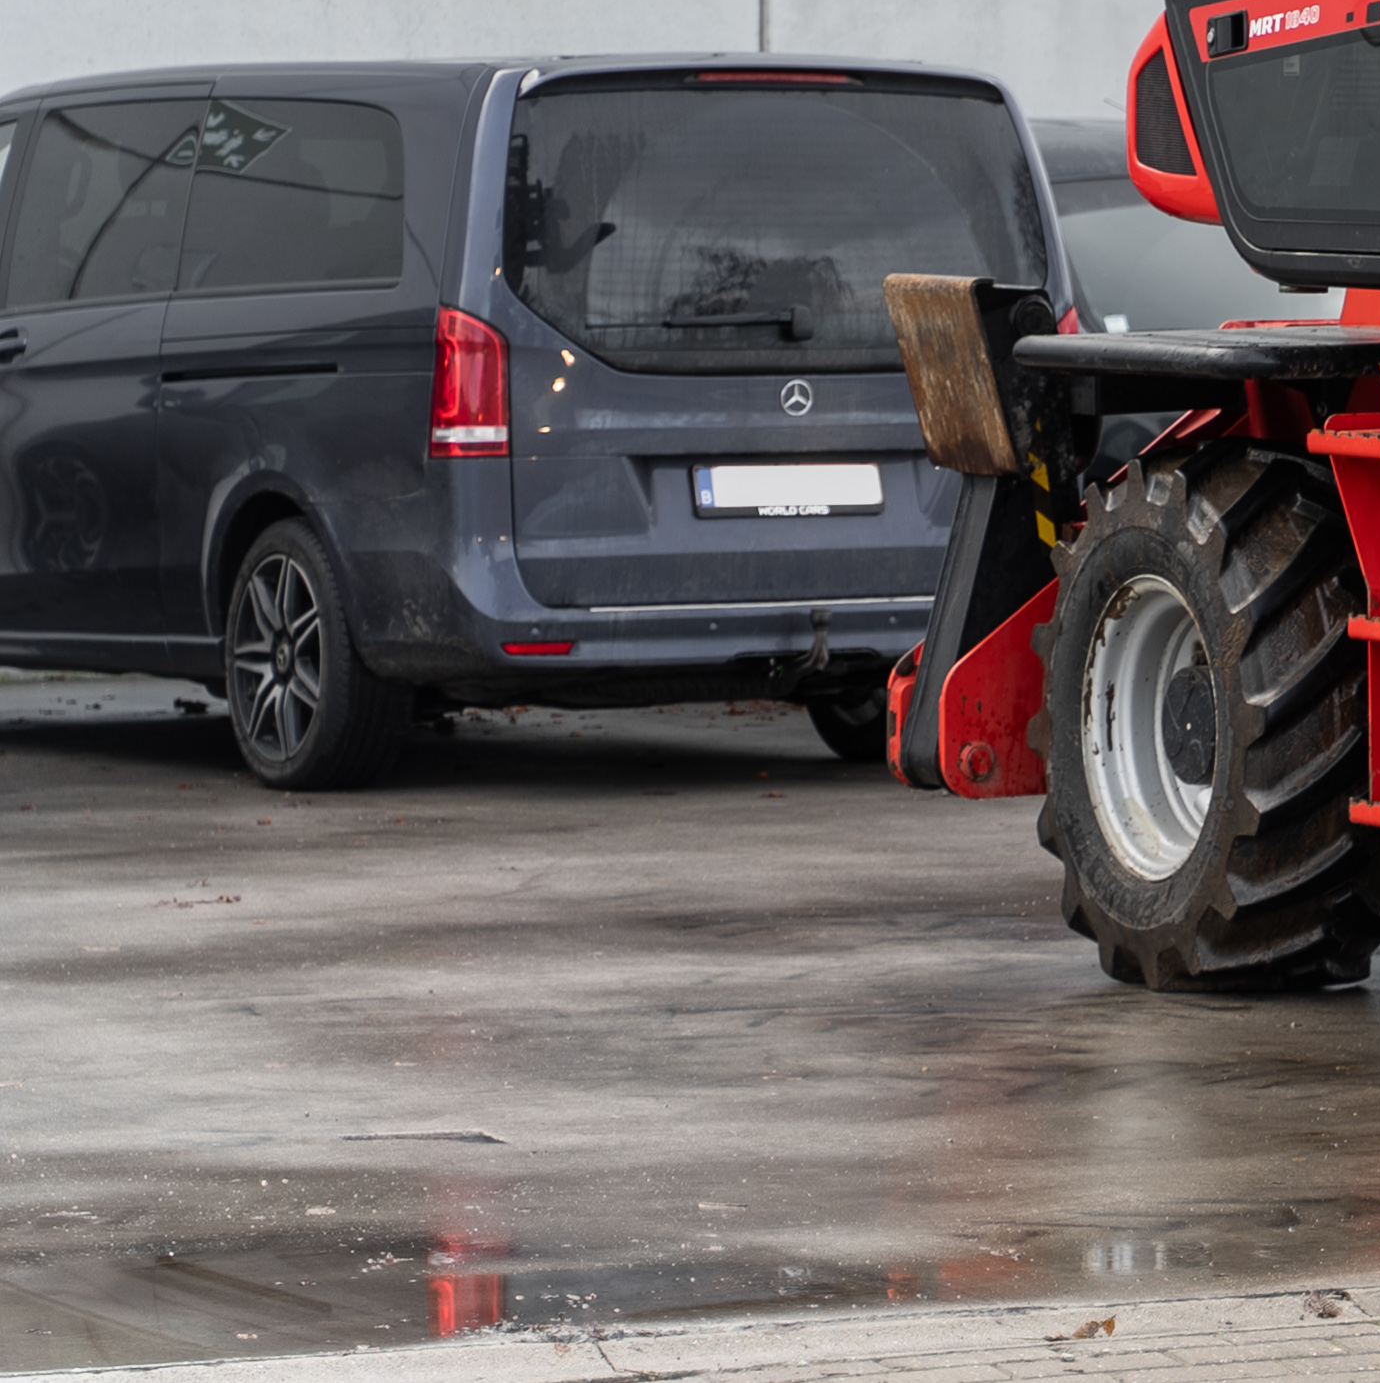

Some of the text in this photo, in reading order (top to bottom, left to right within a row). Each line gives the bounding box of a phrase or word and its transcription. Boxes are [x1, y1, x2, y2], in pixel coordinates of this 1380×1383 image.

[1248, 4, 1320, 39] MRT 1840
[700, 489, 713, 505] B
[757, 505, 831, 516] WORLD CARS
